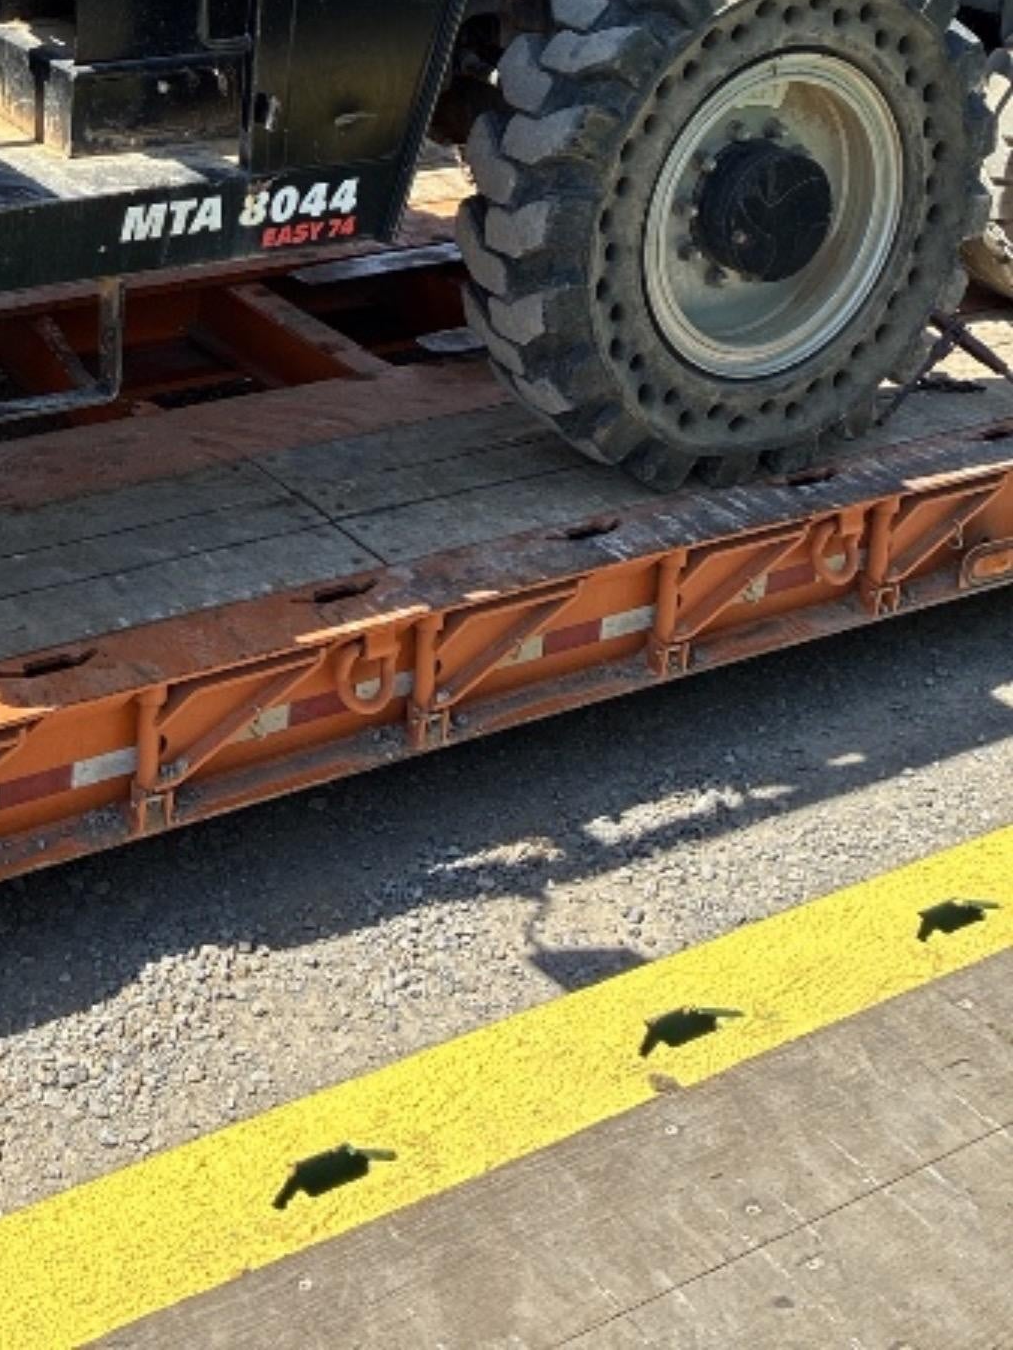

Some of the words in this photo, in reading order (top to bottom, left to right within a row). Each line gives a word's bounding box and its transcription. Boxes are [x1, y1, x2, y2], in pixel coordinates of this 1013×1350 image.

[119, 194, 223, 243] MTA
[238, 177, 360, 227] 8044
[261, 220, 325, 249] EASY
[328, 215, 358, 237] 74
